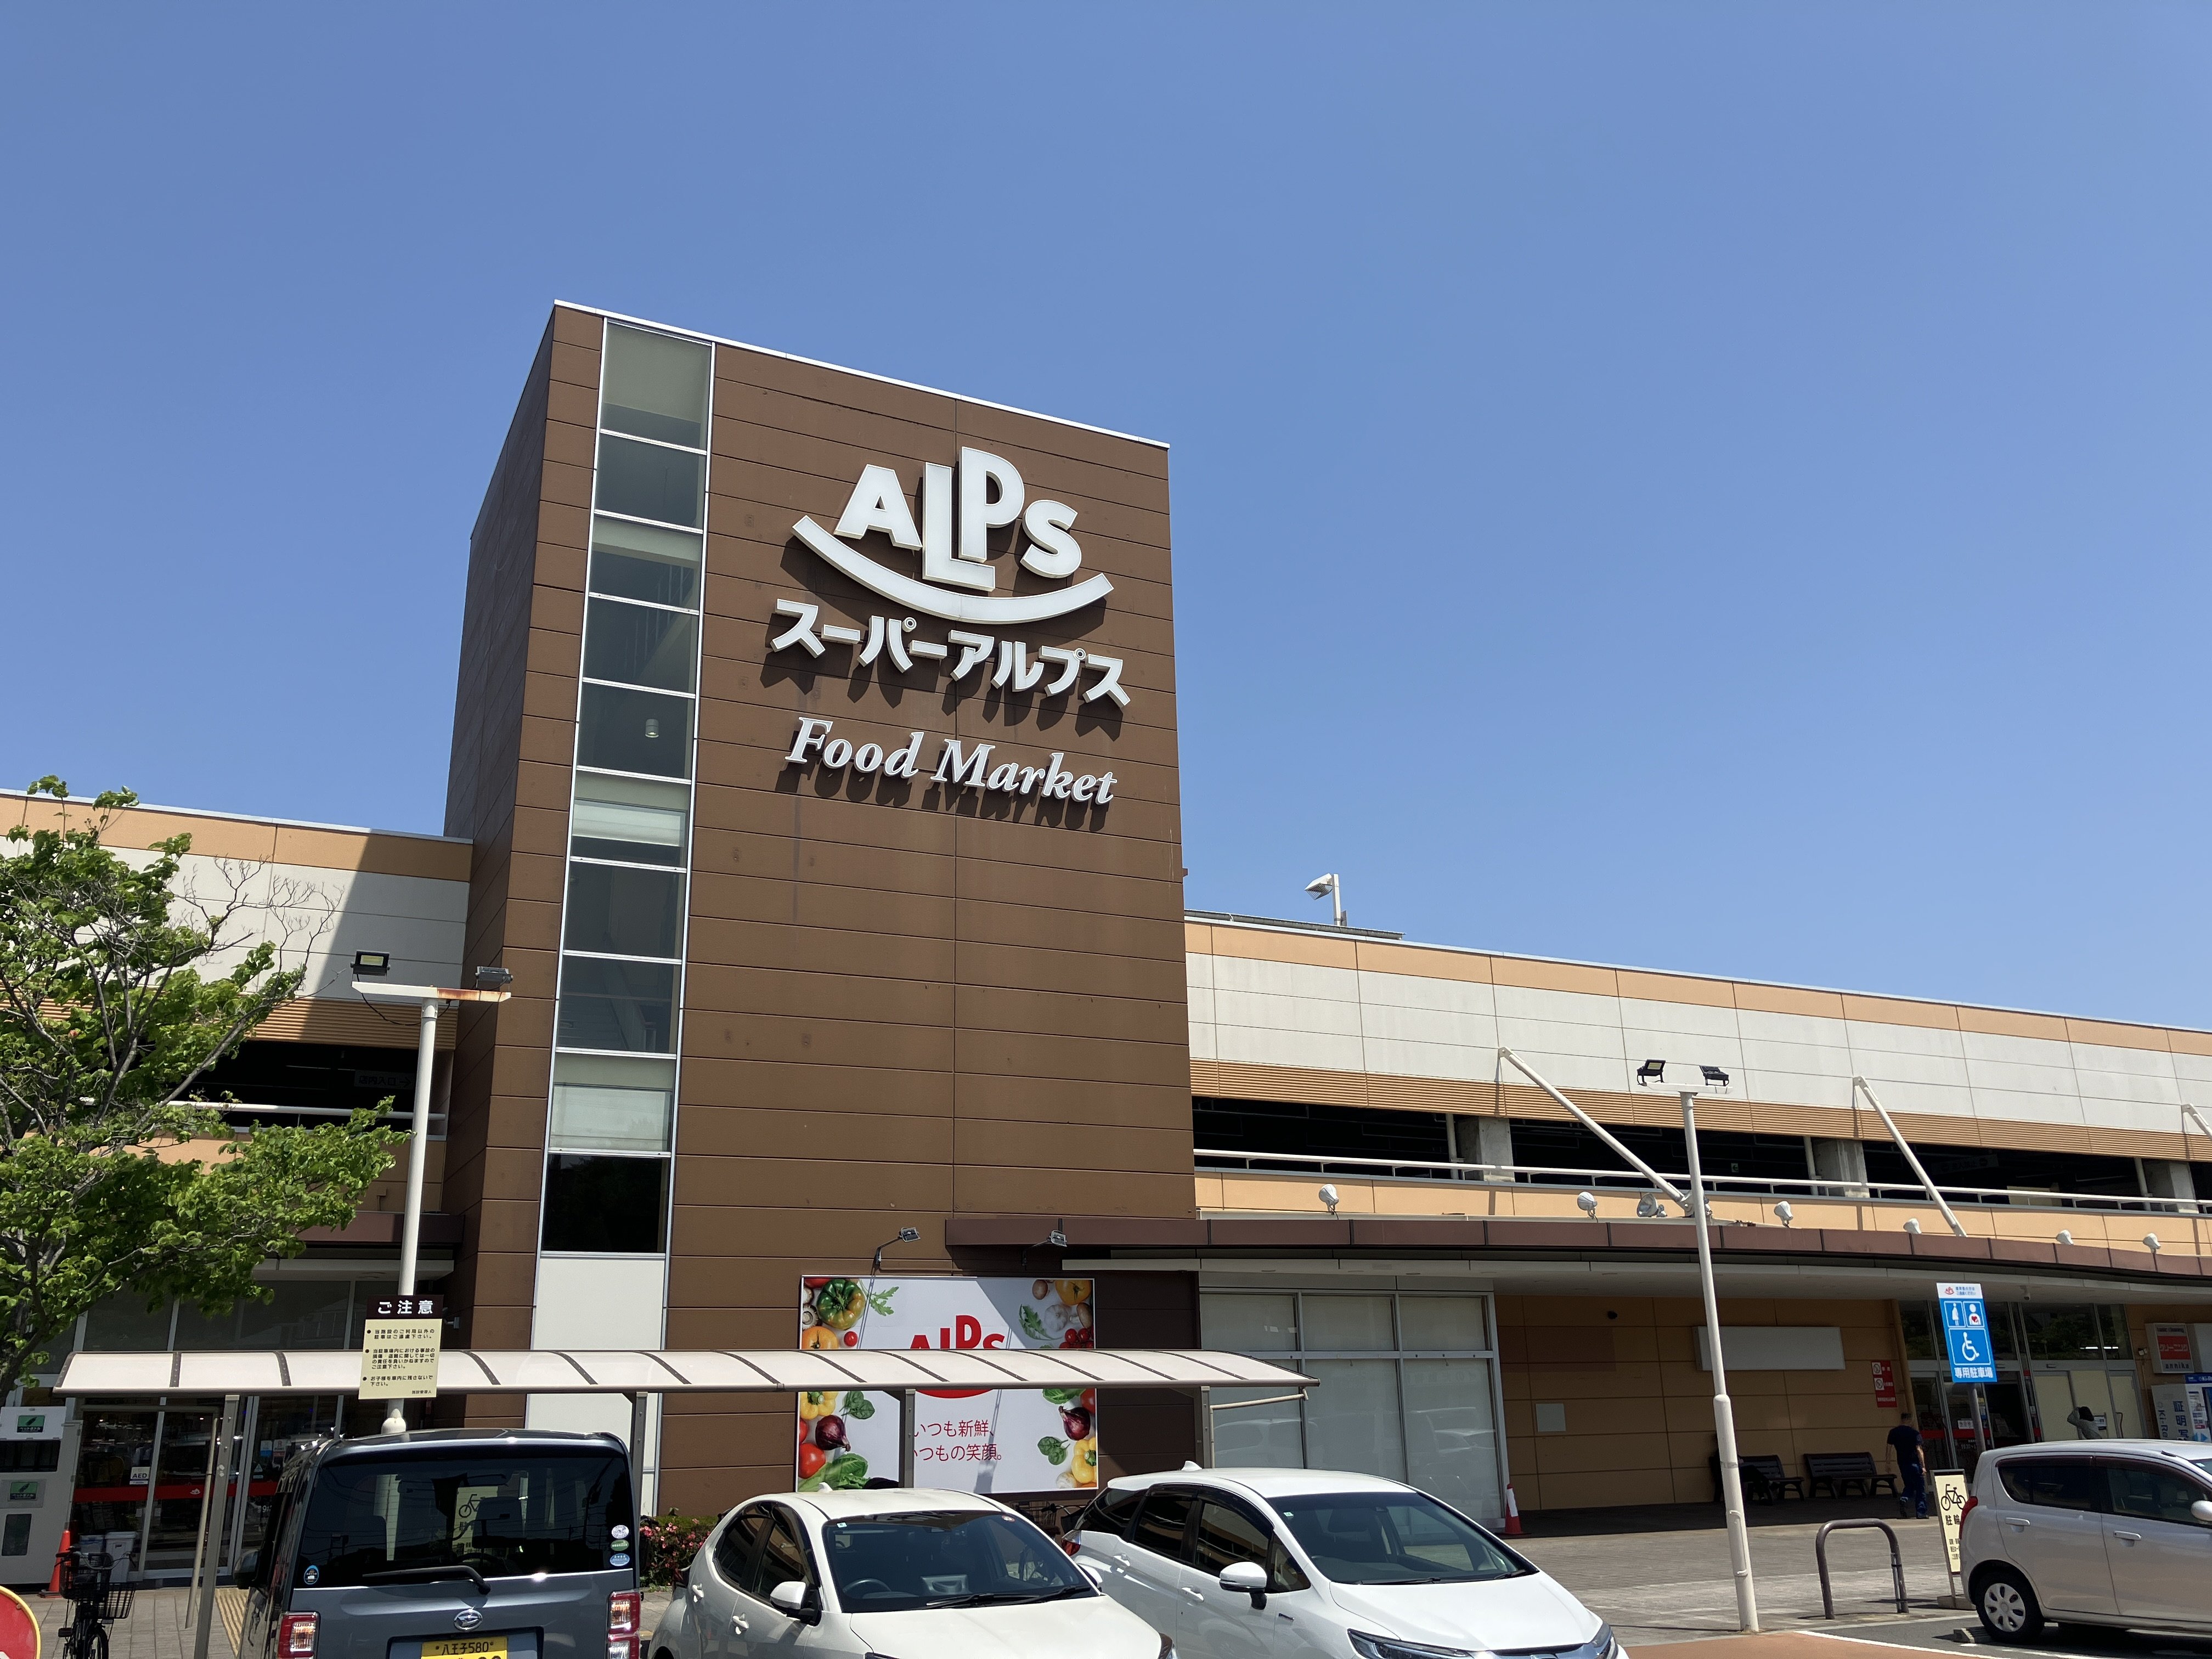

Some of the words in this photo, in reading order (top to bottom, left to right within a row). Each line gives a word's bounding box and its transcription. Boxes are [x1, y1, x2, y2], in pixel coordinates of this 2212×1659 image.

[770, 598, 1131, 708] スーパーアルプス
[785, 716, 925, 778] Food
[931, 738, 1118, 804] Market
[359, 1075, 396, 1086] 店内入口
[377, 1300, 433, 1314] ご注意
[1954, 1367, 1993, 1378] 専用駐車場
[913, 1443, 1002, 1462] つもの笑顔。
[442, 1641, 489, 1655] 八王子580
